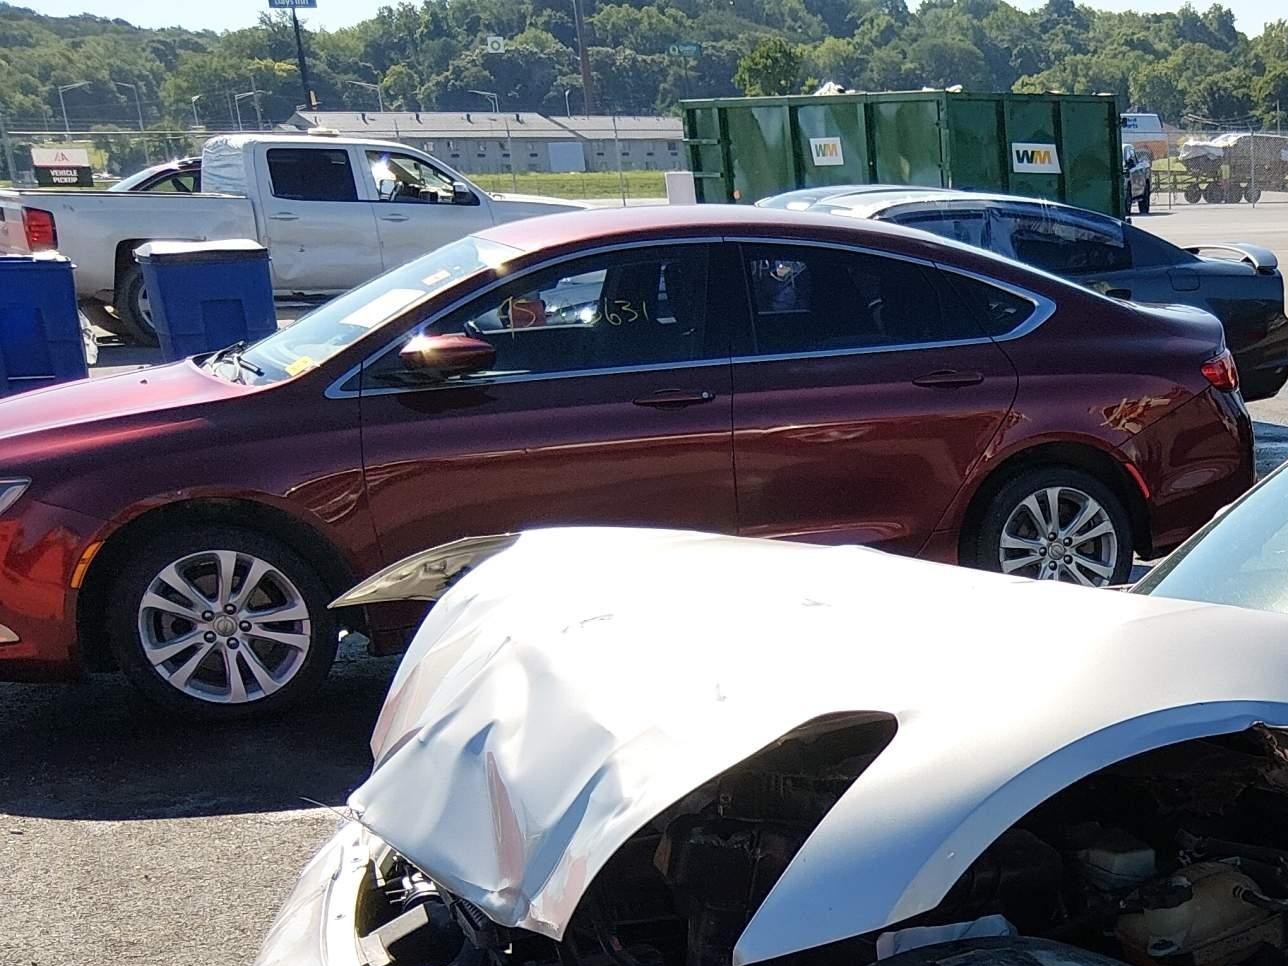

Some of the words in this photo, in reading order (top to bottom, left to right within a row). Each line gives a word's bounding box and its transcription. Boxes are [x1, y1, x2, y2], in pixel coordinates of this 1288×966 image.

[814, 143, 839, 158] WM
[1015, 149, 1051, 165] WM
[49, 169, 79, 177] VEHICLE
[52, 176, 79, 184] PICKUP
